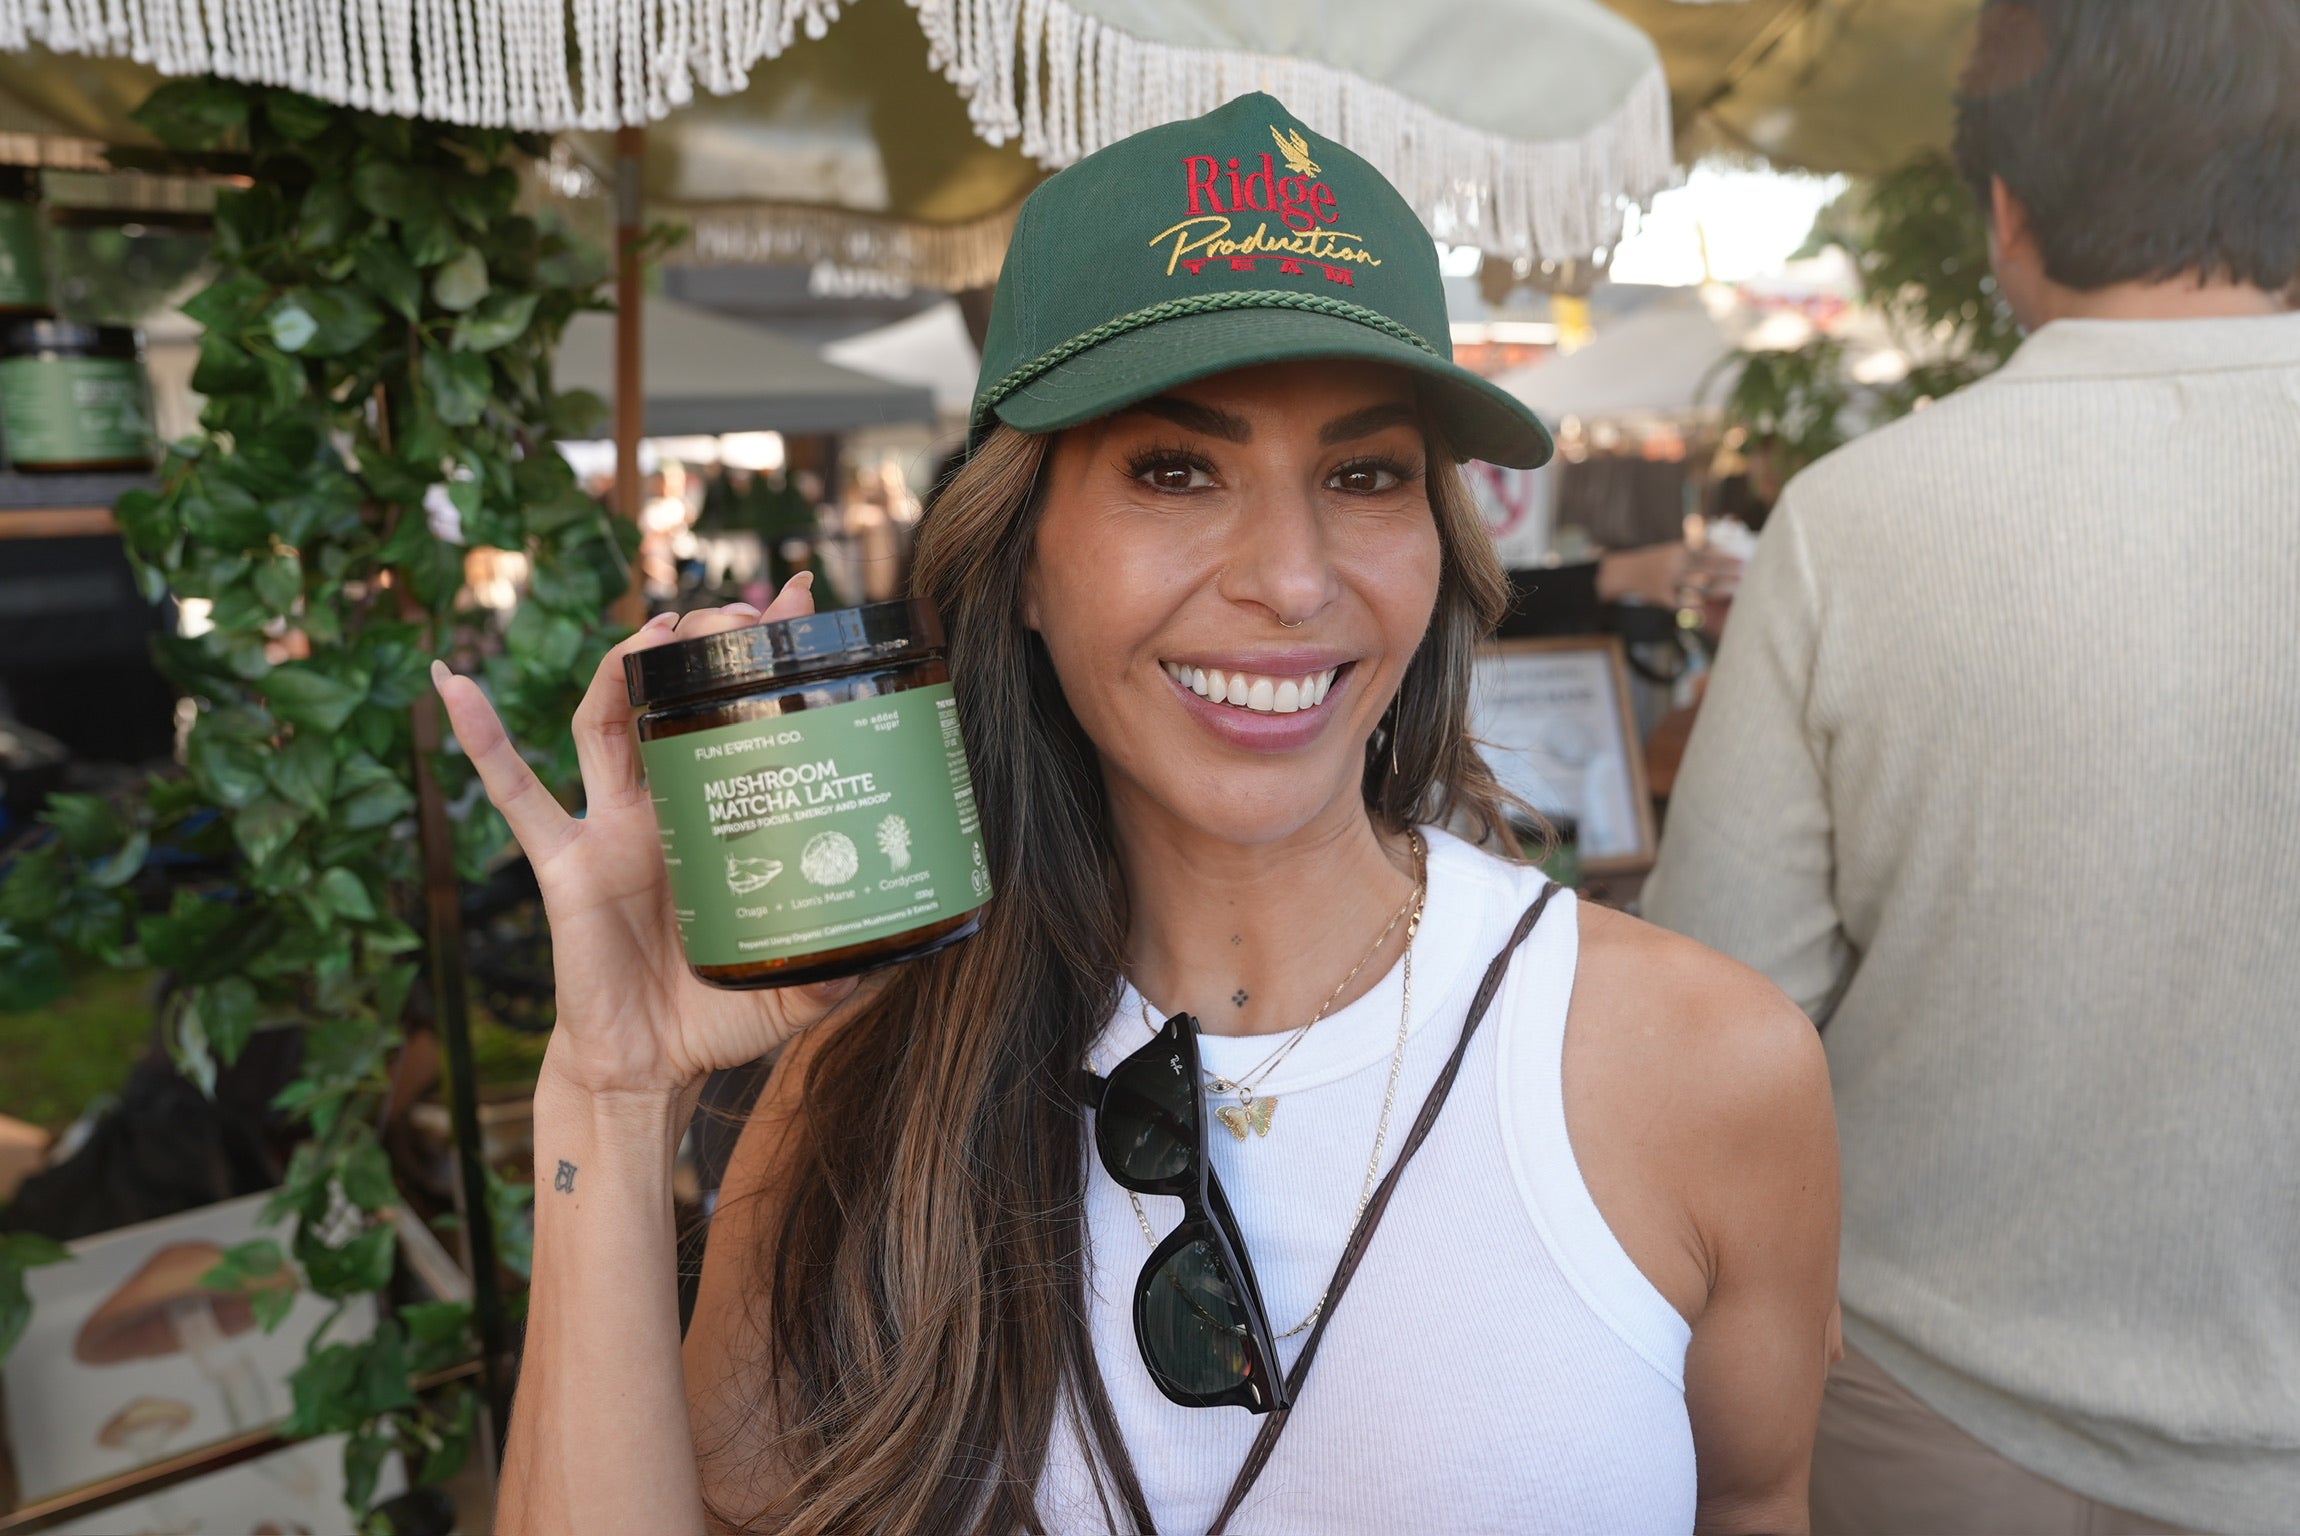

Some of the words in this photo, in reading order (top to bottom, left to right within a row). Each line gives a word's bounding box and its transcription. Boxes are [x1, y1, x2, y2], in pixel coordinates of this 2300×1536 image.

[1181, 152, 1340, 231] Ridge
[1149, 215, 1382, 276] Production
[1181, 255, 1355, 288] TEAM
[694, 745, 723, 761] FUN
[777, 730, 804, 745] CO.
[704, 759, 838, 802] MUSHROOM
[708, 789, 802, 822] MATCHA
[804, 773, 876, 804] LATTE
[712, 819, 757, 836] IMPROVES
[793, 804, 834, 821] ENERGY
[834, 799, 858, 813] AND
[736, 906, 769, 919] Chaga
